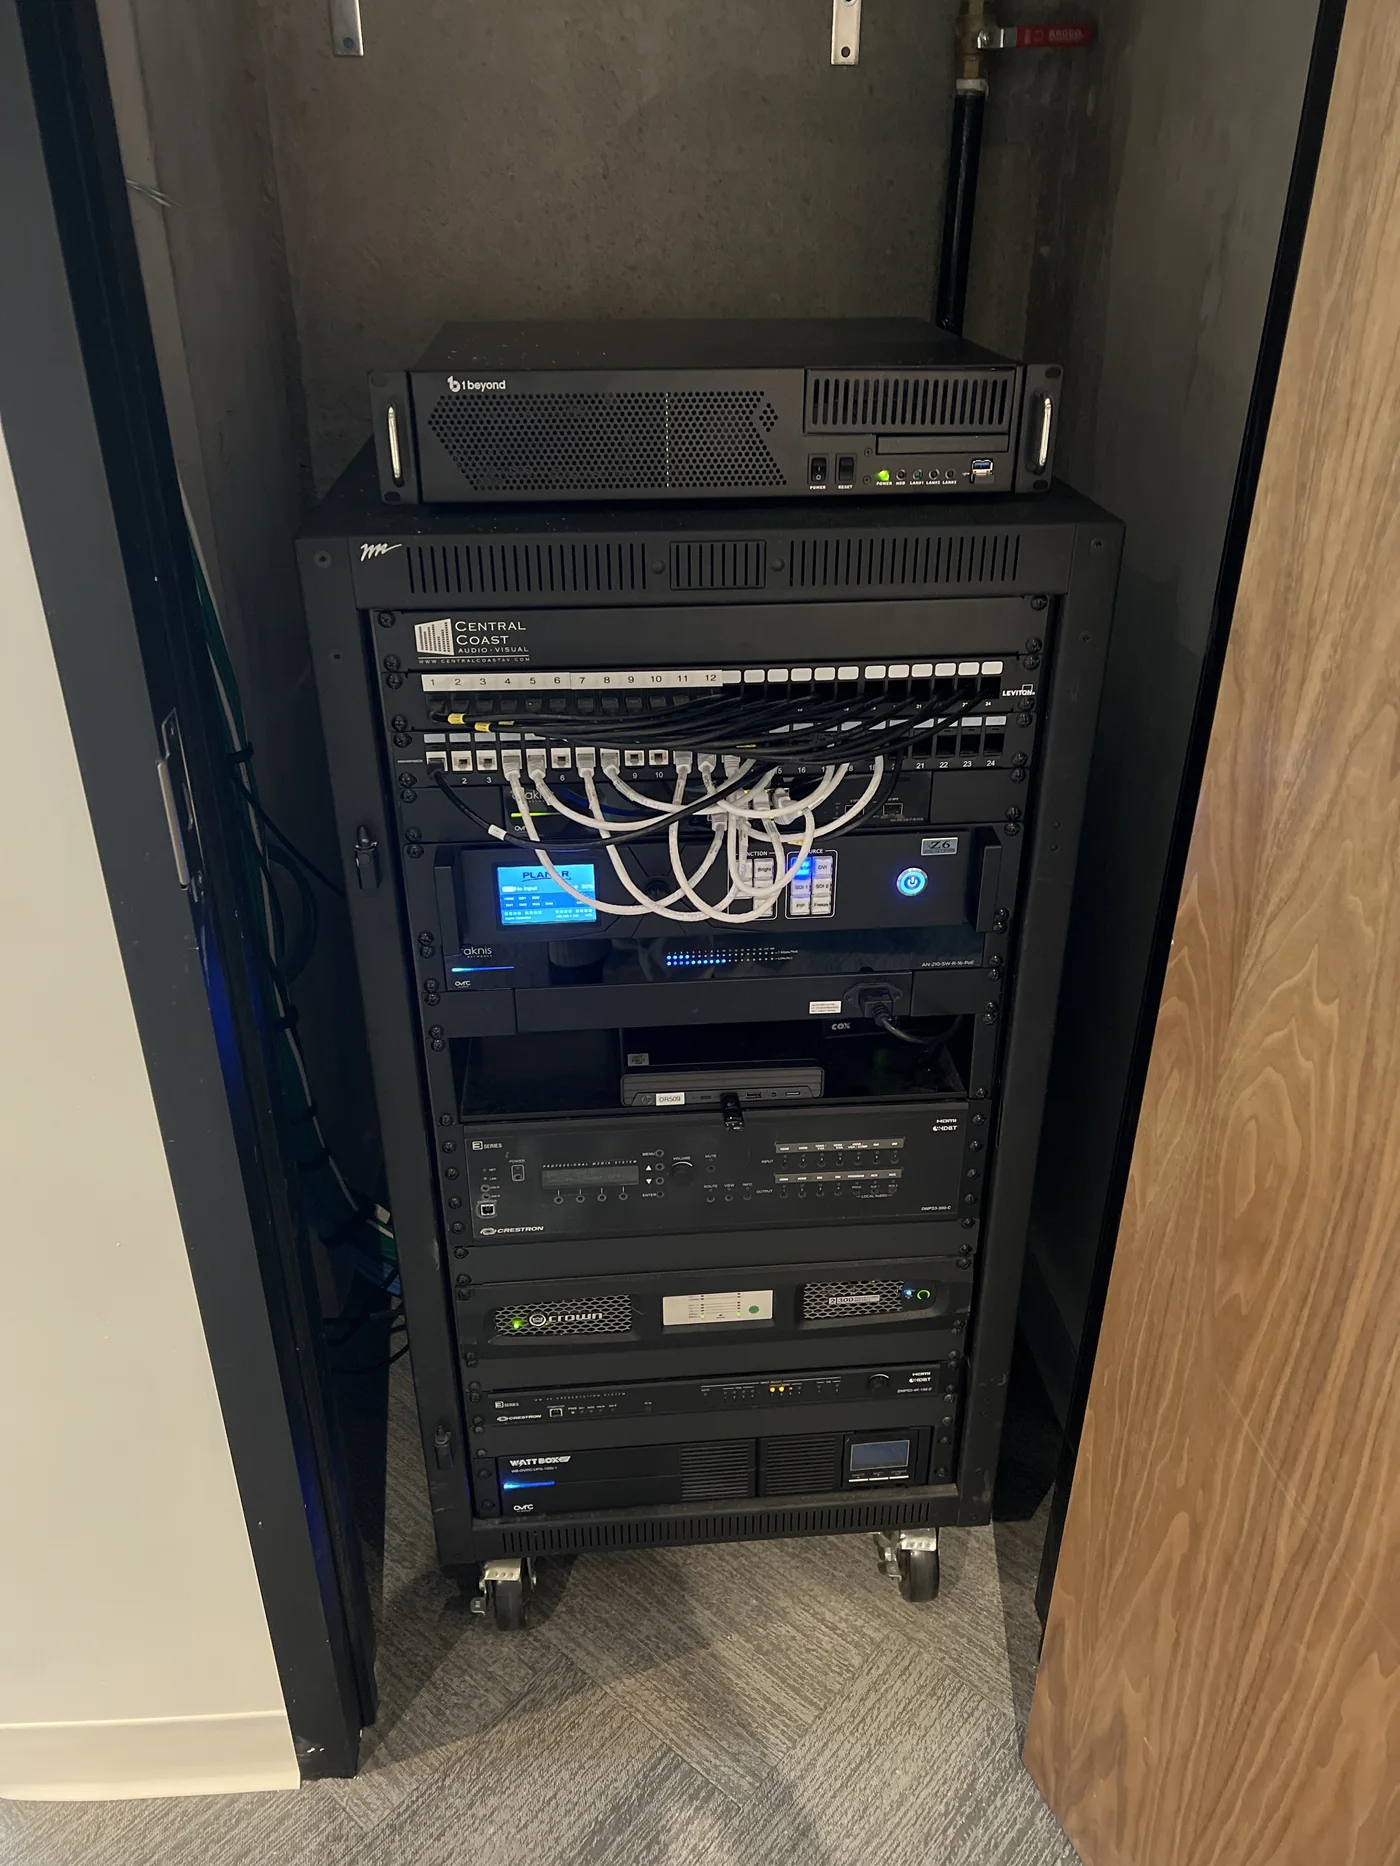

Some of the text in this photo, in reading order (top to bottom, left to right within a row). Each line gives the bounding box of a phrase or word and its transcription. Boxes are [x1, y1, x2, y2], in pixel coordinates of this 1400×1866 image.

[455, 621, 526, 632] CENTRAL
[456, 635, 509, 646] COAST
[430, 678, 435, 686] 1
[454, 678, 461, 686] 2
[529, 677, 536, 685] 5
[554, 676, 561, 684] 6
[579, 676, 585, 684] 7
[603, 676, 610, 684] 8
[650, 675, 662, 683] 10
[705, 674, 717, 682] 12
[461, 777, 467, 785] 2
[560, 774, 565, 782] 6
[655, 771, 664, 779] 10
[797, 766, 806, 774] 16
[497, 1226, 544, 1234] CRESTRON
[549, 1312, 603, 1323] crown
